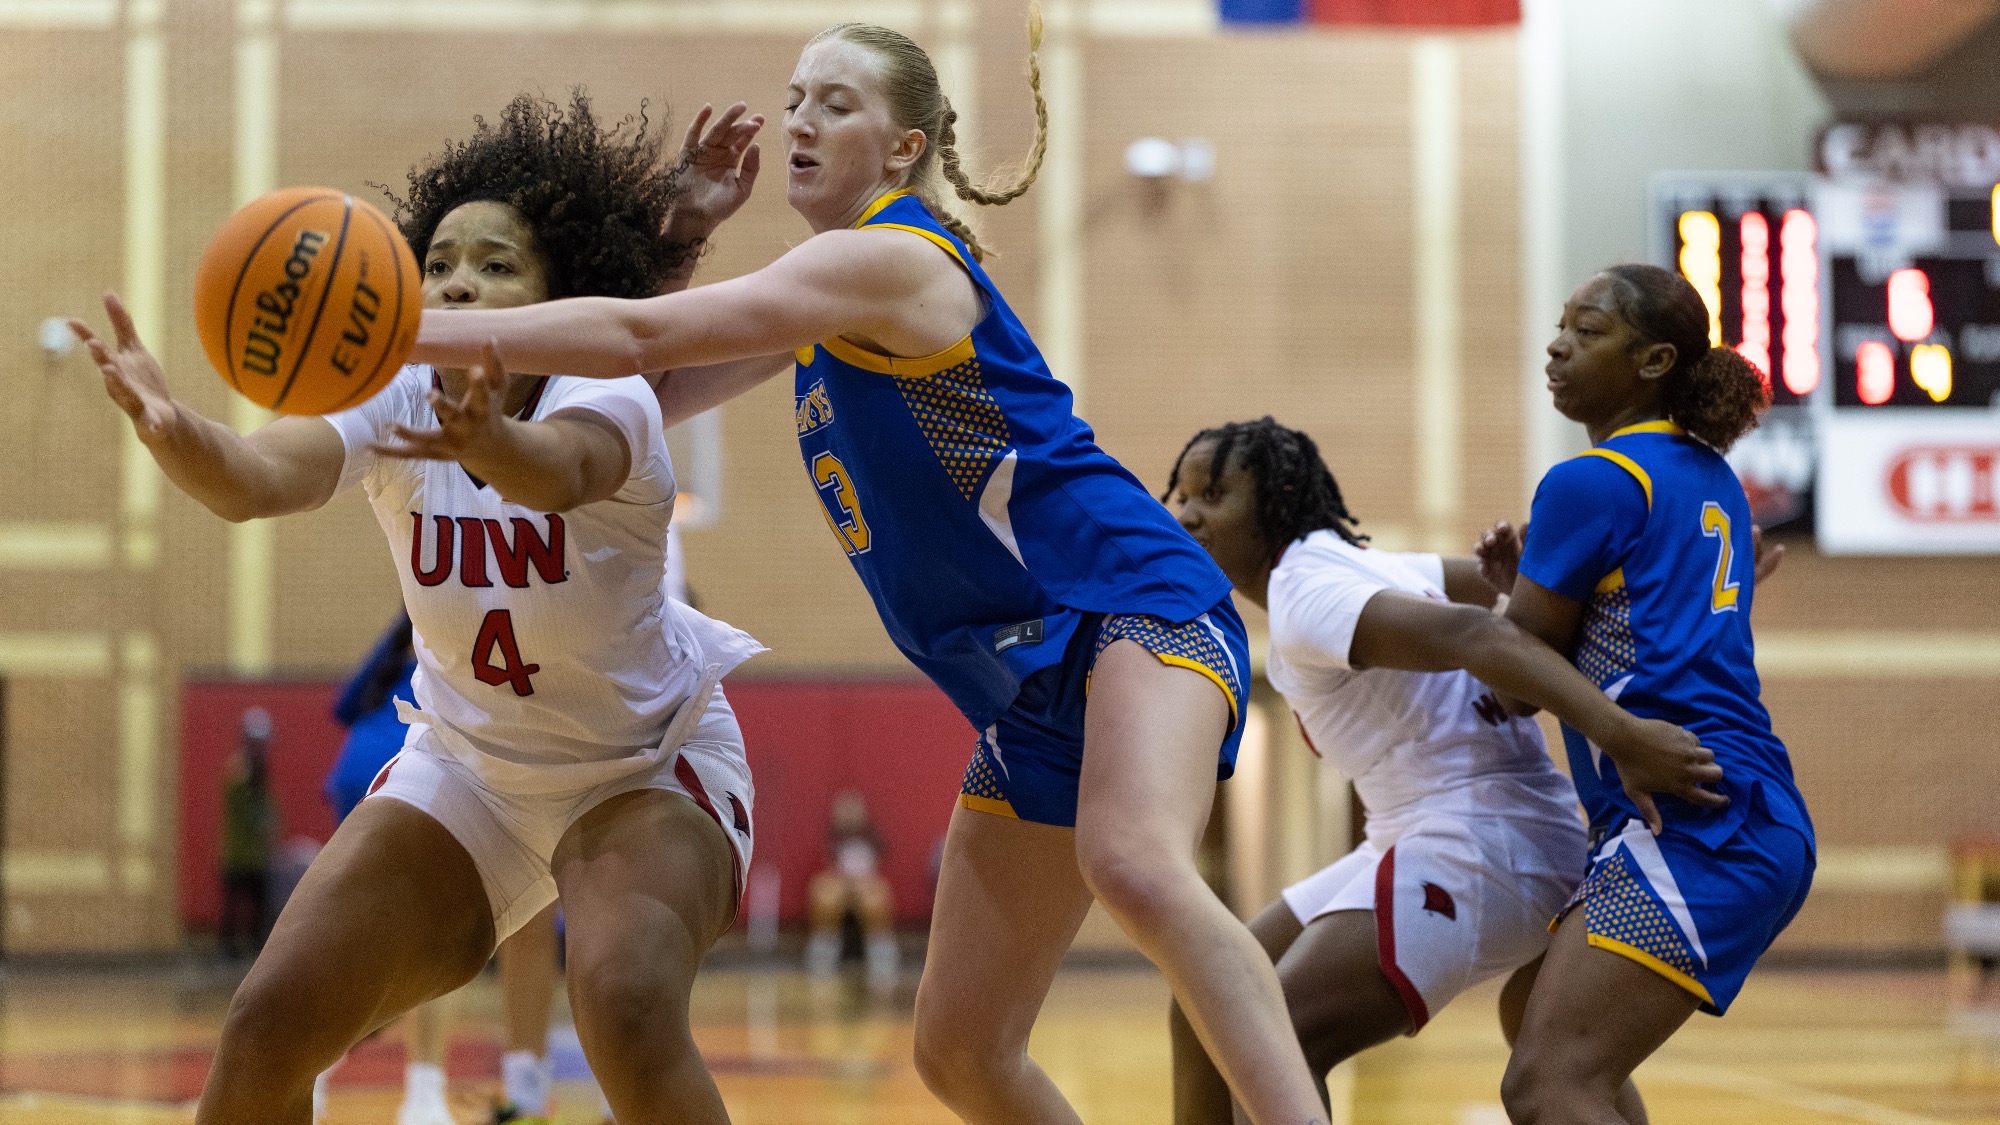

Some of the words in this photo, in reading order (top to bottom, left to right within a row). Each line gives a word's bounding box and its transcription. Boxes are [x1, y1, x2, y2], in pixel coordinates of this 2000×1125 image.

[242, 230, 328, 376] Wilson
[410, 511, 569, 588] UIW
[1700, 500, 1741, 615] 2
[471, 608, 541, 697] 4
